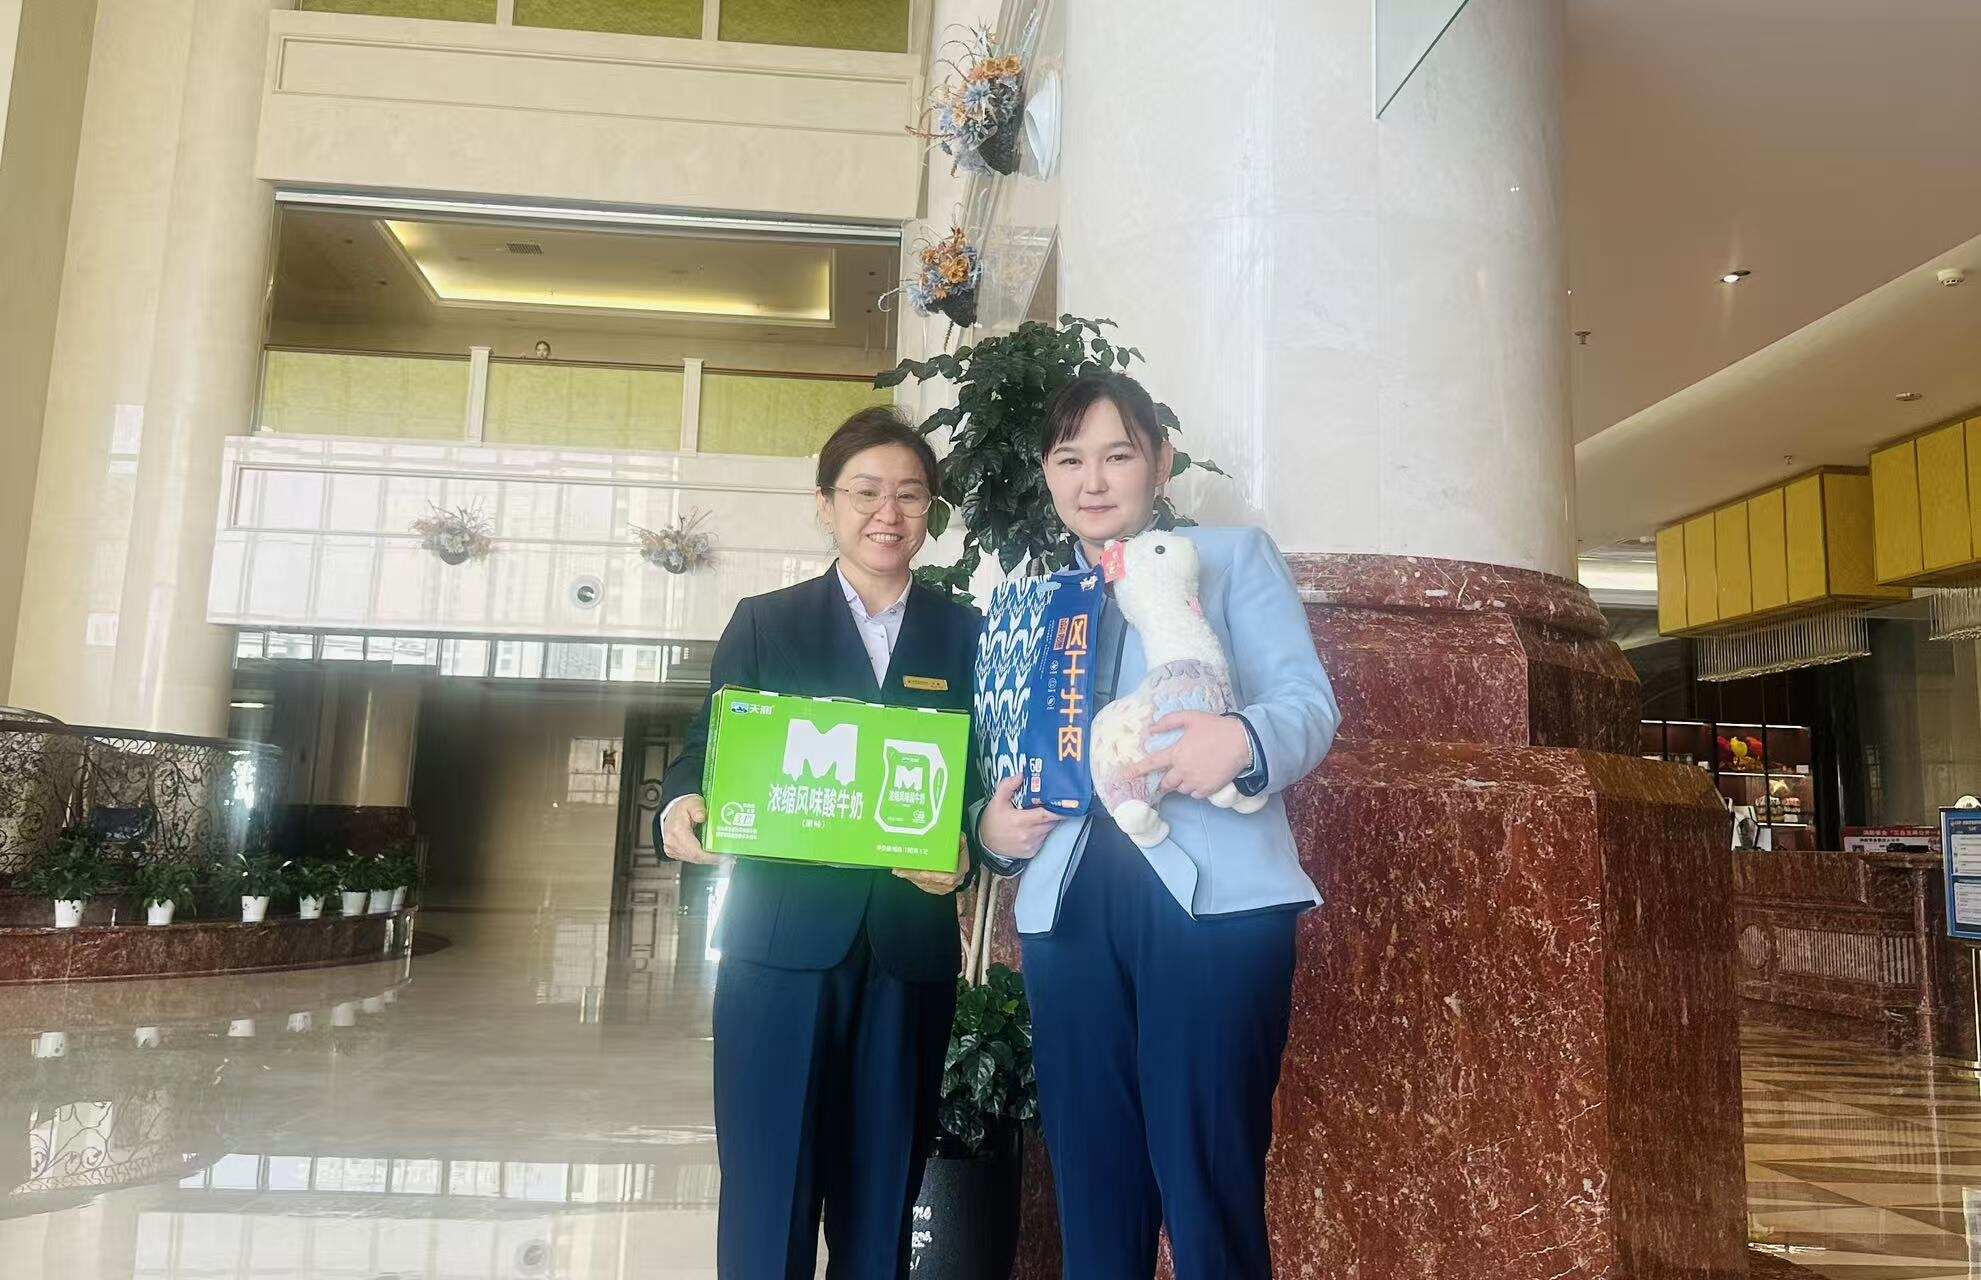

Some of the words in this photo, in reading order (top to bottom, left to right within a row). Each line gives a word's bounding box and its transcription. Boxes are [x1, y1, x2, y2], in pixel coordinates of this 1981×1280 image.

[1058, 614, 1088, 762] 风干牛肉
[767, 783, 864, 821] 浓缩风味酸牛奶
